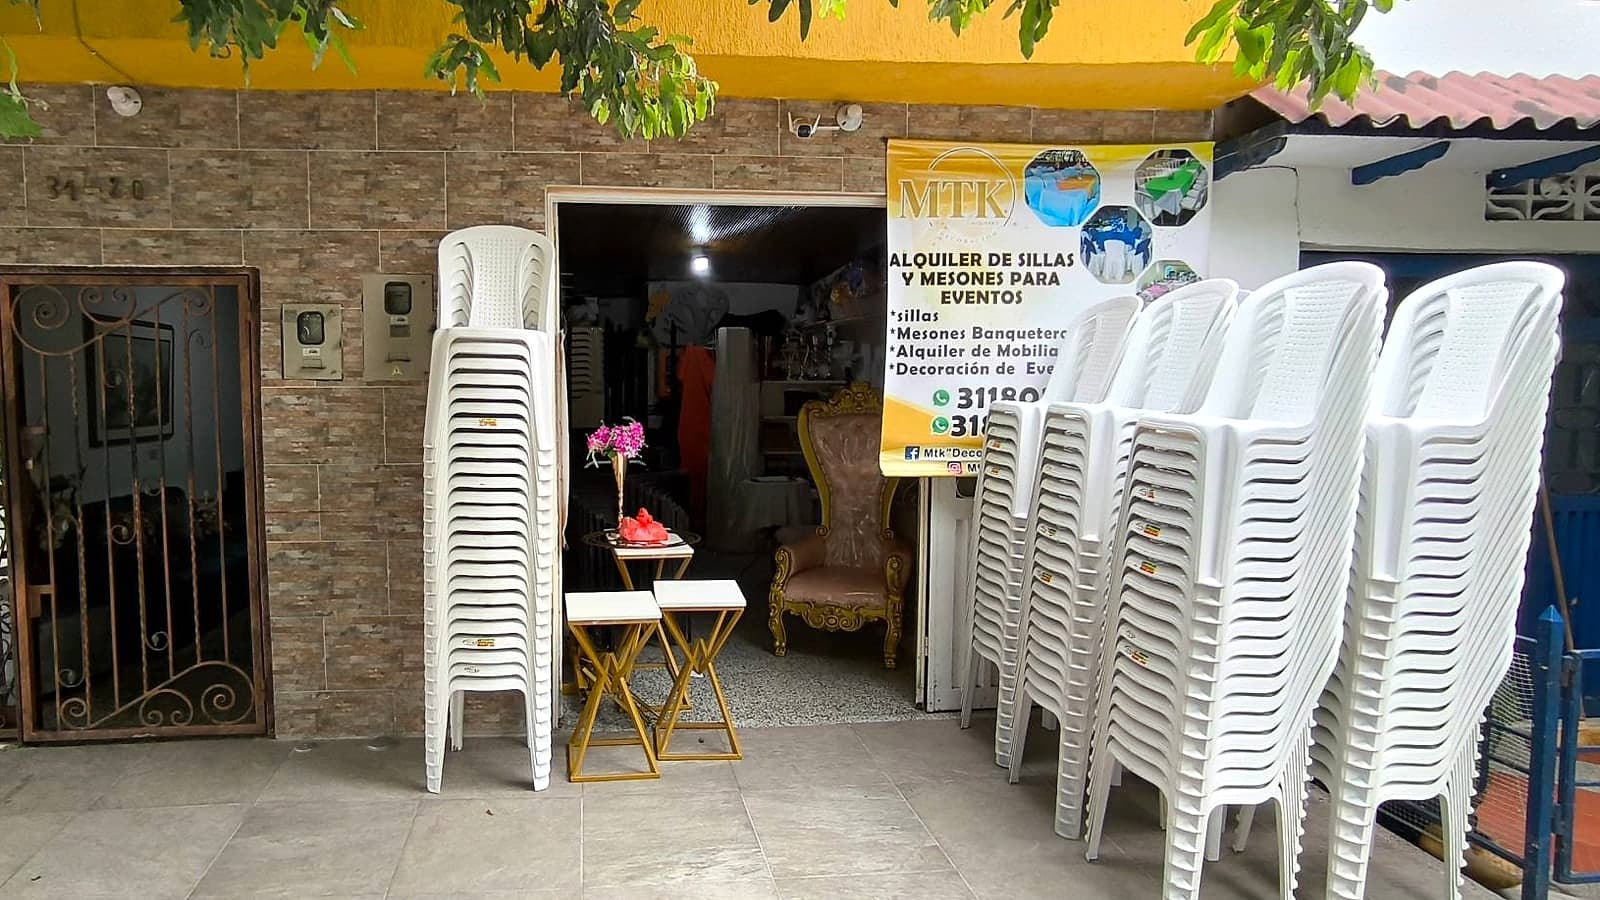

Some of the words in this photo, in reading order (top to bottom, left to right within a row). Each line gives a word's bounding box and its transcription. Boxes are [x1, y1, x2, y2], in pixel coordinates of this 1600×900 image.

[898, 180, 1007, 219] MTK
[889, 252, 983, 269] ALQUILER
[988, 252, 1012, 267] DE
[1018, 252, 1074, 267] SILLAS
[901, 271, 914, 286] Y
[920, 271, 1004, 286] MESONES
[1010, 271, 1061, 286] PARA
[941, 290, 1023, 305] EVENTOS
[971, 344, 991, 357] de
[997, 344, 1058, 357] Mobilia
[996, 361, 1015, 375] de
[957, 386, 1047, 409] 31180
